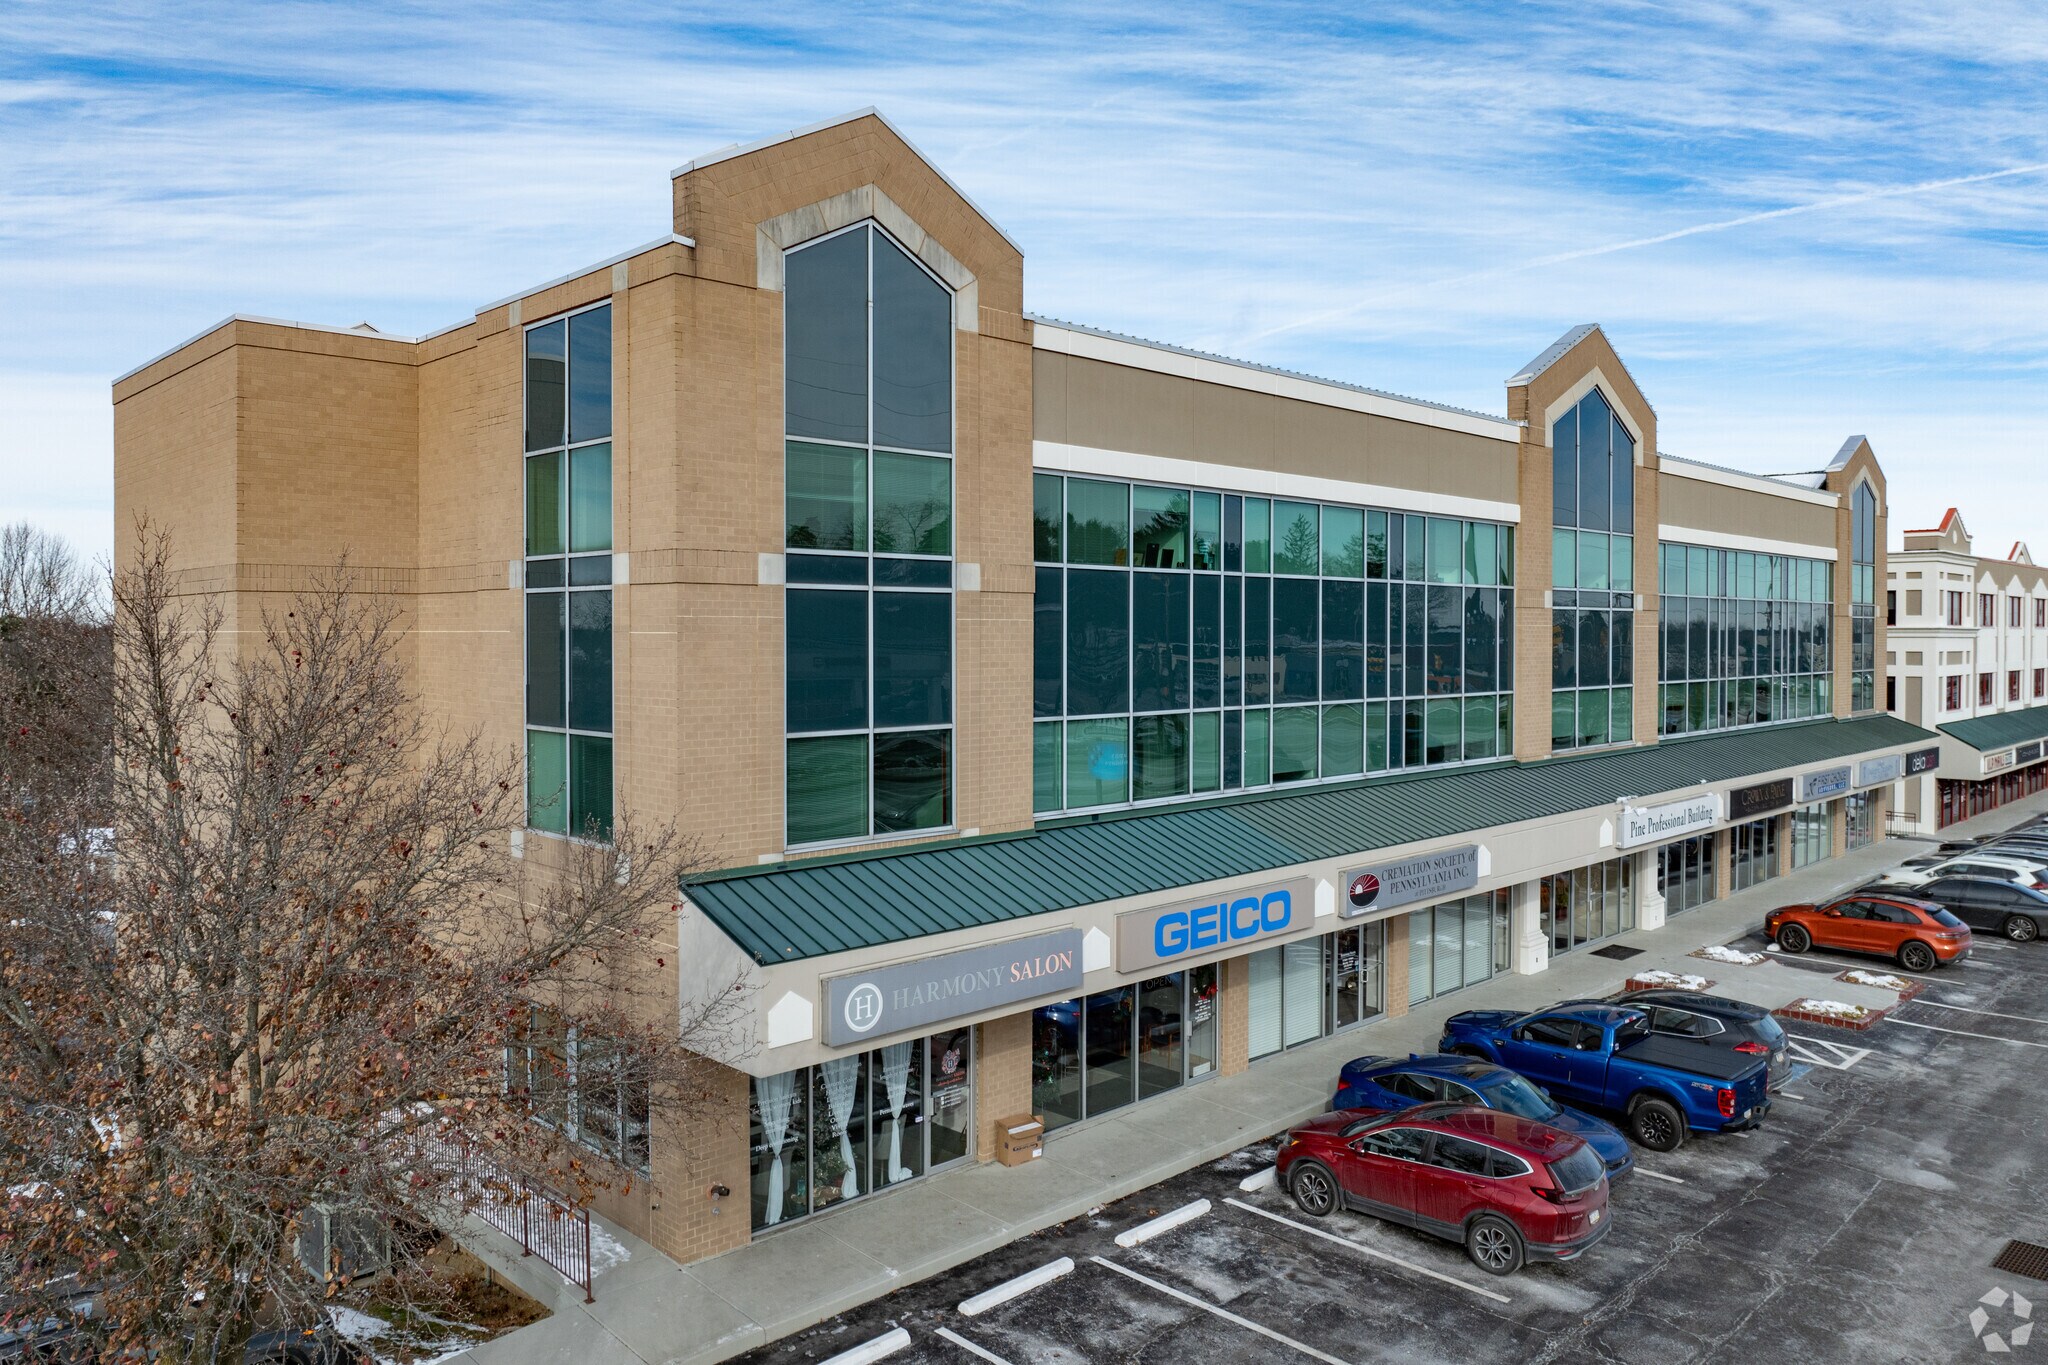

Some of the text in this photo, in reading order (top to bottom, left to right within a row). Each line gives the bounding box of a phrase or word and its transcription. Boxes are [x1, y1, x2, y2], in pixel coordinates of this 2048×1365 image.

[1630, 804, 1713, 838] Pine Professional Building
[1381, 849, 1477, 882] CREMATION SOCIETY of
[1390, 866, 1469, 895] PENNSYLVANIA INC.
[1154, 890, 1291, 957] GEICO
[855, 950, 1073, 1021] H HARMONY SALON
[1146, 975, 1172, 990] OPEN
